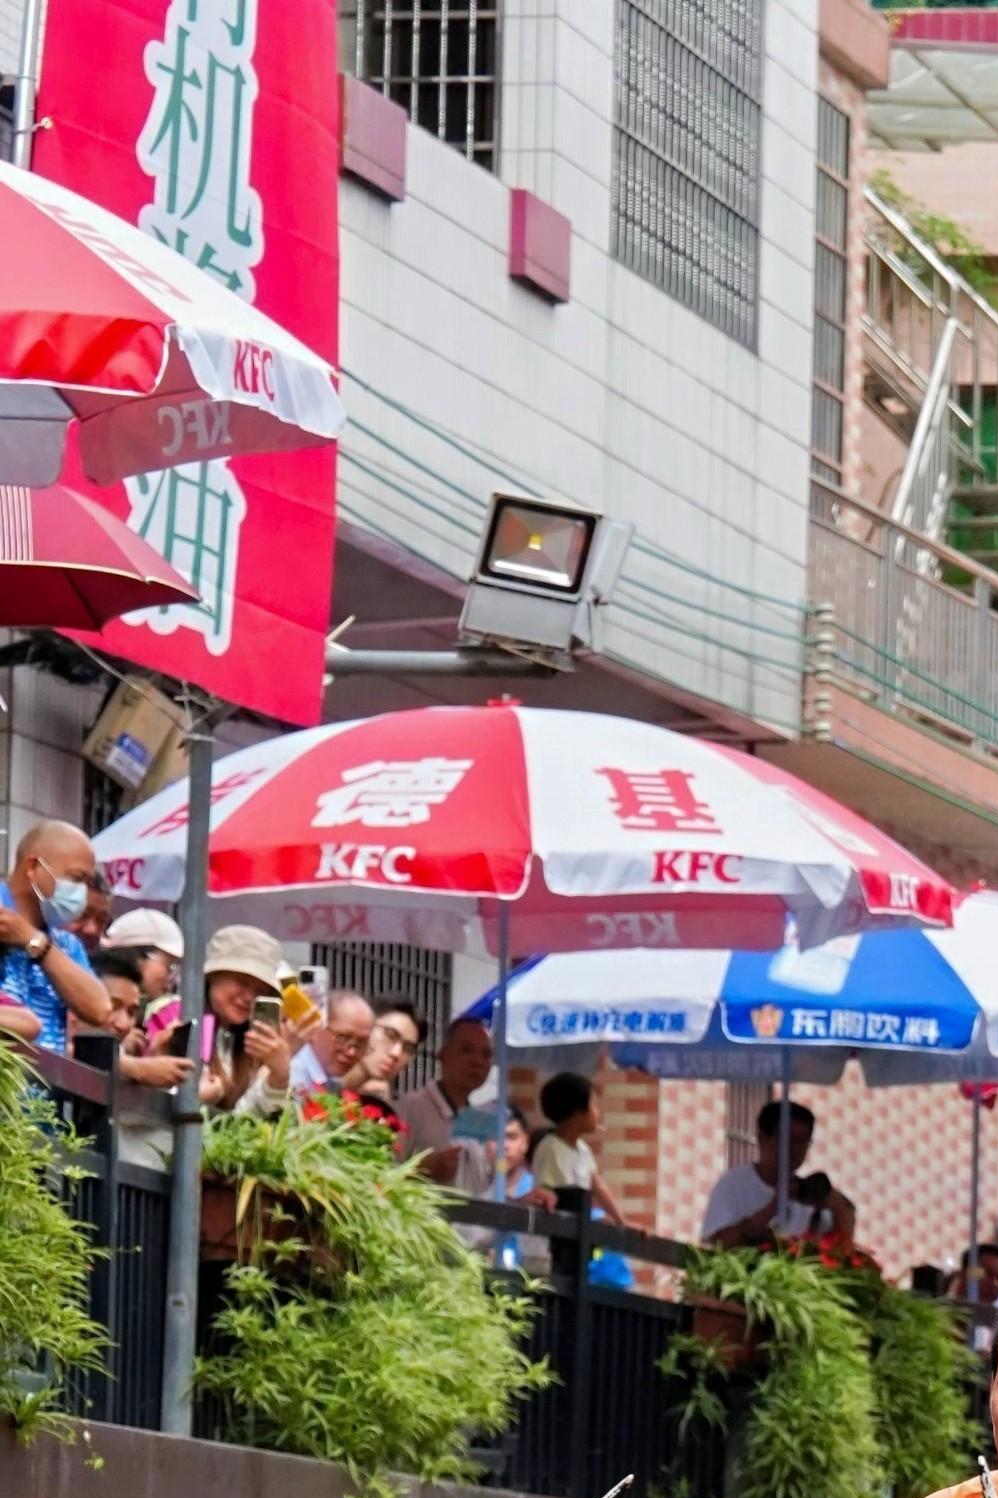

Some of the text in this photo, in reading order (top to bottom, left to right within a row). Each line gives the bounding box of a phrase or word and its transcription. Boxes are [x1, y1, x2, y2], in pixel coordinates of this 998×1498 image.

[233, 340, 275, 401] KFC
[311, 757, 474, 828] 德
[594, 767, 723, 834] 基
[314, 842, 416, 883] KFC
[650, 850, 742, 884] KFC
[791, 1007, 940, 1046] 东鹏饮料
